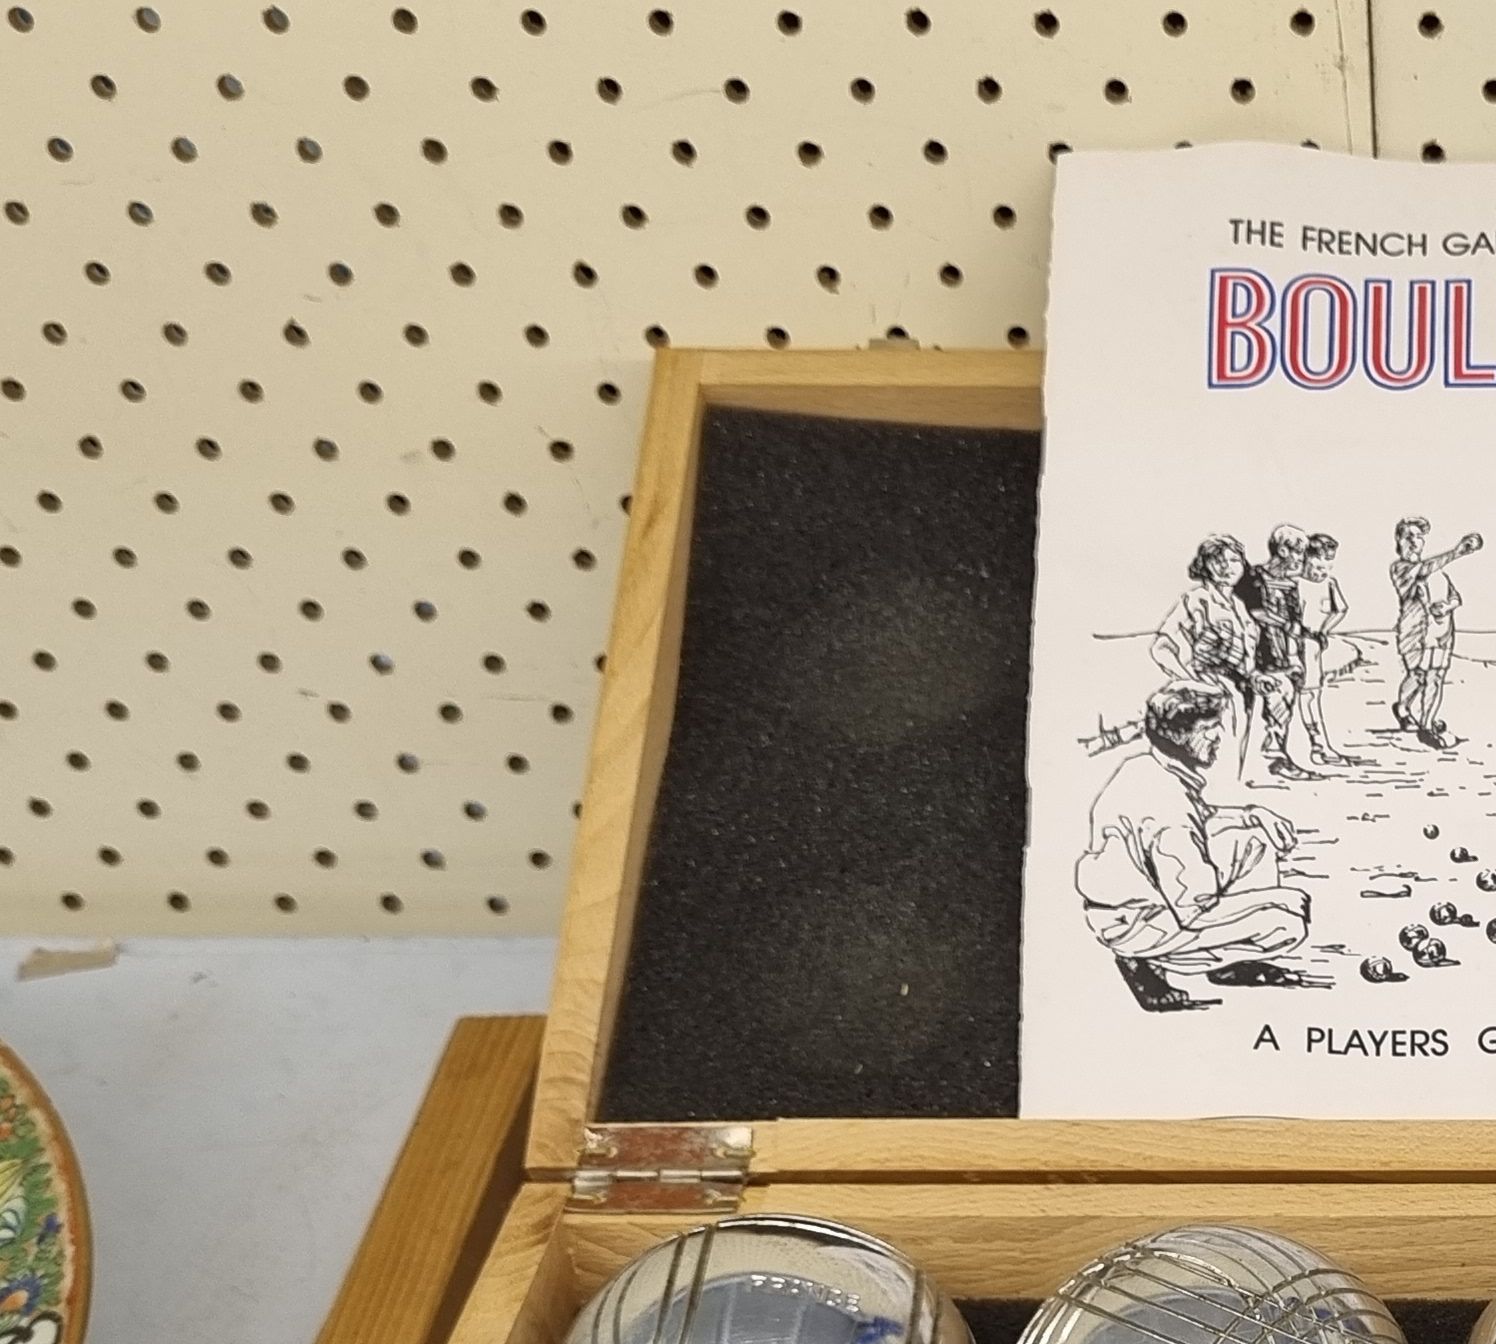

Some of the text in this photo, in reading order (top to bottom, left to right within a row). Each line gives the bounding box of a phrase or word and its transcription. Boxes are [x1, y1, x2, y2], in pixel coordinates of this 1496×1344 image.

[1228, 218, 1285, 248] THE
[1302, 225, 1428, 257] FRENCH
[1253, 1023, 1280, 1052] A
[1306, 1026, 1450, 1057] PLAYERS
